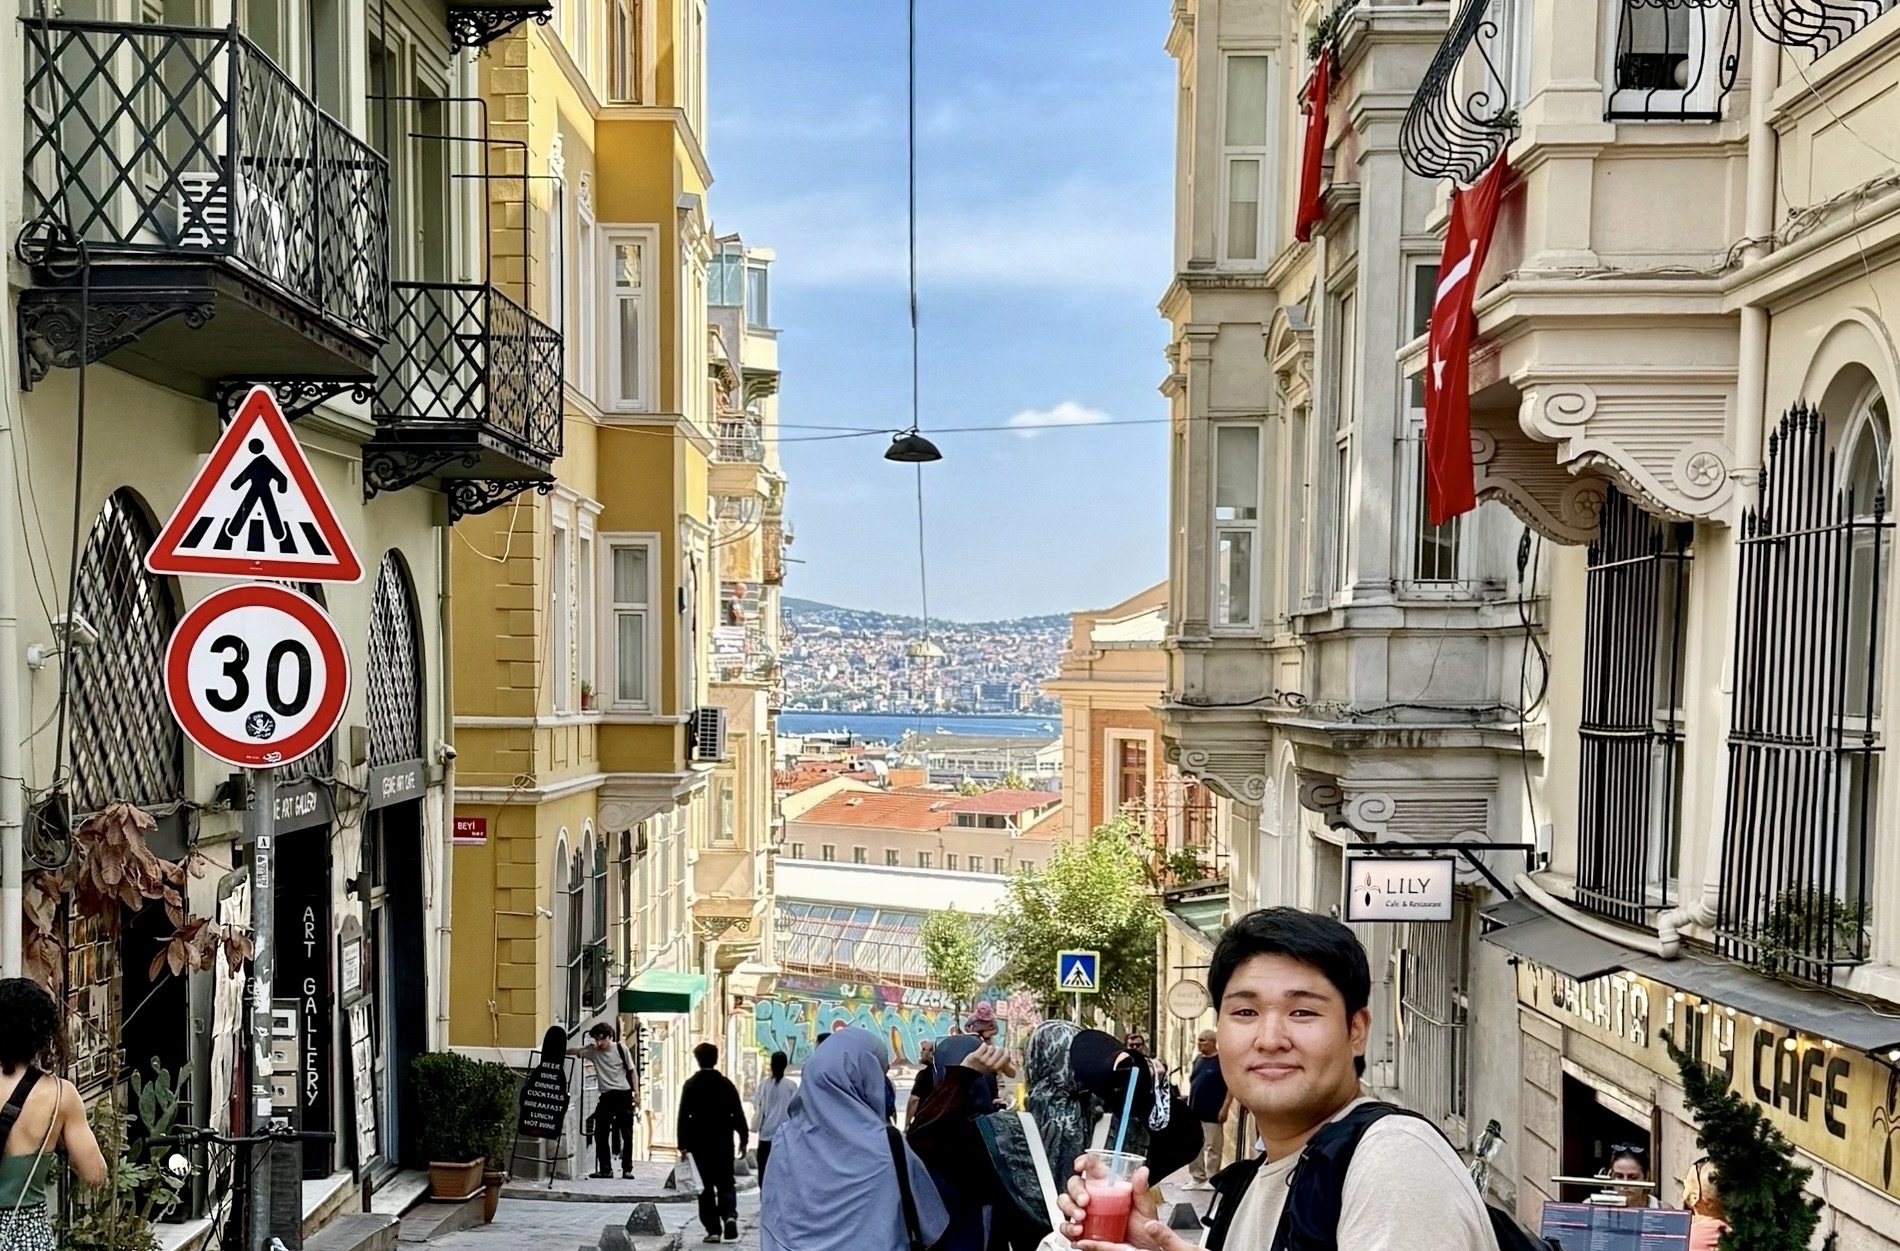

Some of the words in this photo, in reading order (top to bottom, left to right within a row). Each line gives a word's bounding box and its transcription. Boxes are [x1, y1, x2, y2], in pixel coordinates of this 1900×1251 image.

[205, 634, 312, 717] 30
[282, 797, 294, 818] ART
[1387, 878, 1431, 894] LILY
[303, 906, 315, 958] ART
[303, 977, 319, 1106] GALLERY
[1752, 1028, 1850, 1140] CAFE
[524, 1099, 564, 1112] BREAKFAST
[527, 1089, 565, 1101] COCKTAILS
[530, 1111, 554, 1121] LUNCH
